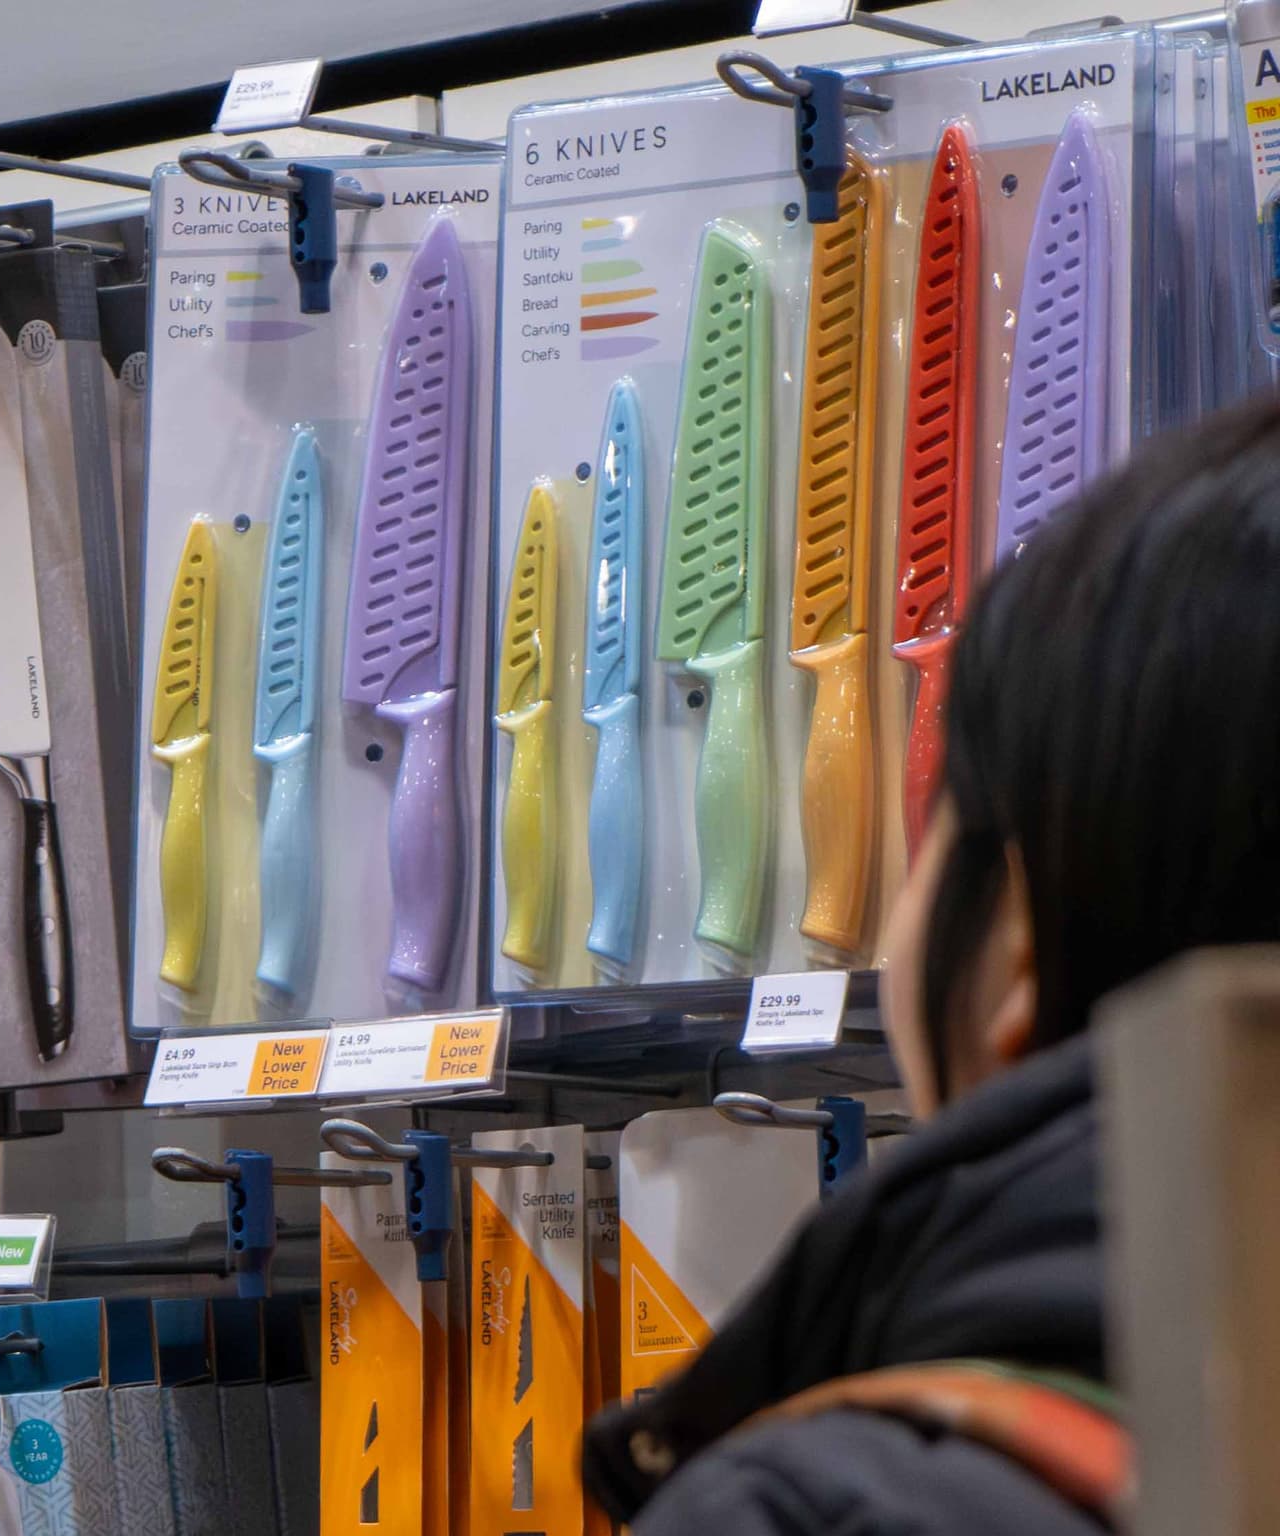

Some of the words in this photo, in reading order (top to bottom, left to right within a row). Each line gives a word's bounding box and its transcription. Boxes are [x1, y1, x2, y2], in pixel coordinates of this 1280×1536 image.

[981, 63, 1116, 103] LAKELAND
[525, 142, 540, 166] 6
[556, 125, 668, 162] KNIVES
[524, 169, 574, 187] Ceramic
[576, 164, 621, 181] Coated
[173, 197, 185, 215] 3
[392, 189, 489, 207] LAKELAND
[172, 219, 233, 236] Ceramic
[523, 220, 563, 235] Paring
[522, 246, 561, 262] Utility
[169, 269, 216, 288] Paring
[522, 270, 573, 287] Santoku
[168, 297, 213, 315] Utility
[521, 296, 558, 312] Bread
[167, 323, 214, 339] Chef's
[521, 321, 570, 339] Carving
[521, 347, 561, 364] Chef's
[26, 655, 40, 719] LAKELAND
[760, 994, 801, 1008] £29.99
[339, 1034, 371, 1047] £4.99
[449, 1026, 481, 1040] New
[164, 1049, 196, 1062] £4.99
[272, 1042, 304, 1057] New
[440, 1044, 484, 1058] Lower
[161, 1061, 191, 1072] Lakeland
[262, 1059, 307, 1074] Lower
[440, 1060, 477, 1075] Price
[262, 1076, 299, 1090] Price
[522, 1192, 576, 1207] Serrated
[539, 1209, 576, 1224] Utility
[542, 1226, 576, 1240] Knife
[482, 1260, 491, 1346] LAKELAND
[637, 1301, 648, 1321] 3
[330, 1281, 339, 1366] LAKELAND
[32, 1438, 39, 1449] 3
[24, 1452, 49, 1462] YEAR
